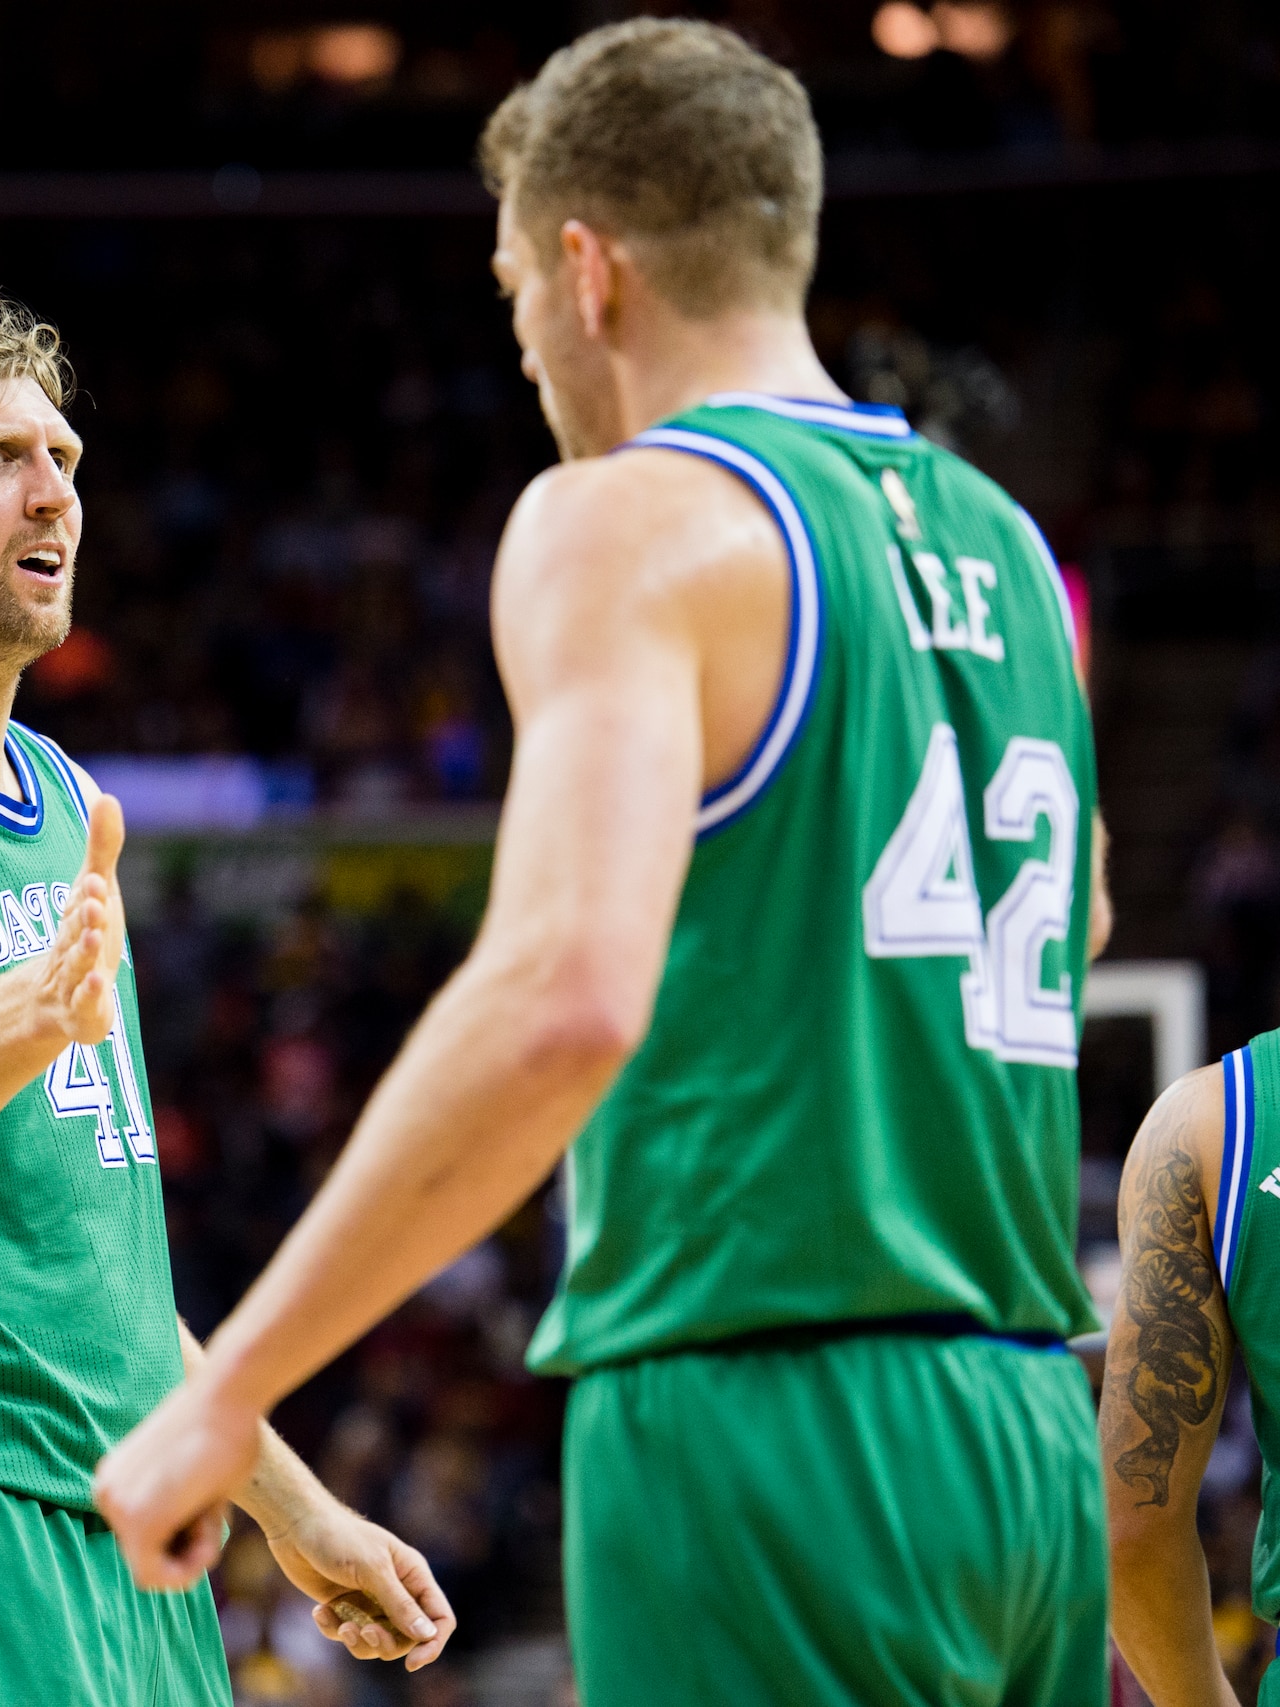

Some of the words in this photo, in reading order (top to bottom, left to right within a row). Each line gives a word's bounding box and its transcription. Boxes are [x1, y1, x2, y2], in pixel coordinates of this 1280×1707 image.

[885, 543, 1005, 663] LEE
[862, 721, 1079, 1069] 42
[44, 982, 156, 1169] 41
